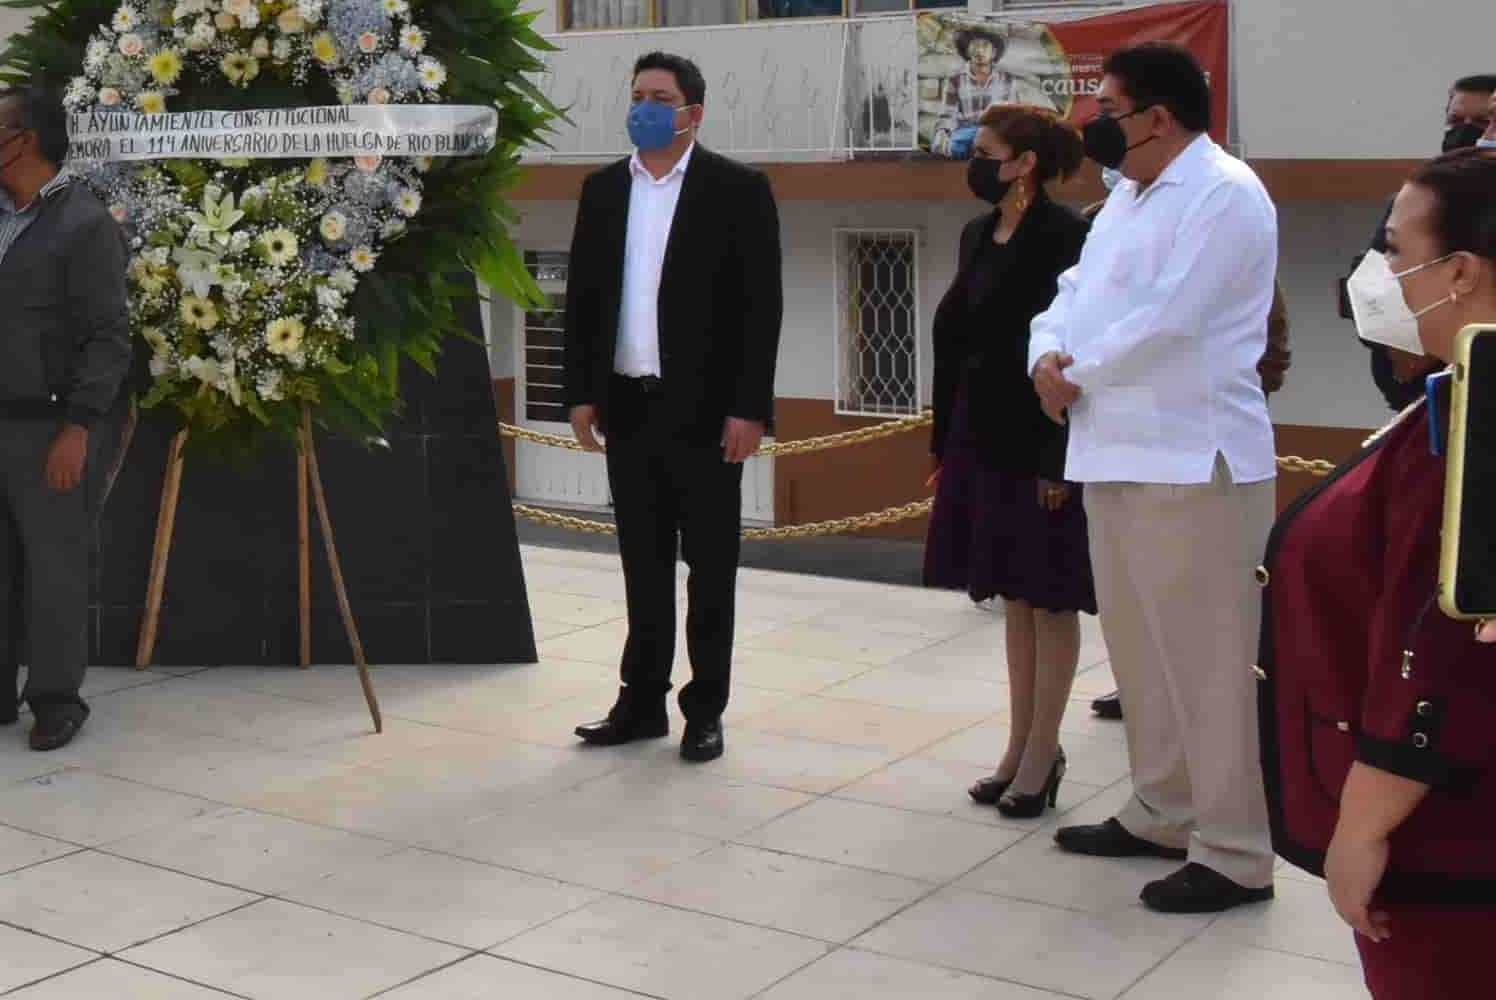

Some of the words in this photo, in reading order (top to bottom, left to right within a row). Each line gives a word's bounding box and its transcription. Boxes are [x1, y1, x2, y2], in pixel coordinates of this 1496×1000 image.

[88, 111, 214, 134] AYUNTAMIENTO
[120, 137, 138, 154] EL
[147, 134, 176, 154] 114
[180, 132, 279, 152] ANIVERSARIO
[281, 132, 303, 151] DE
[304, 132, 321, 152] LA
[326, 131, 383, 151] HUELGA
[385, 135, 401, 151] DE
